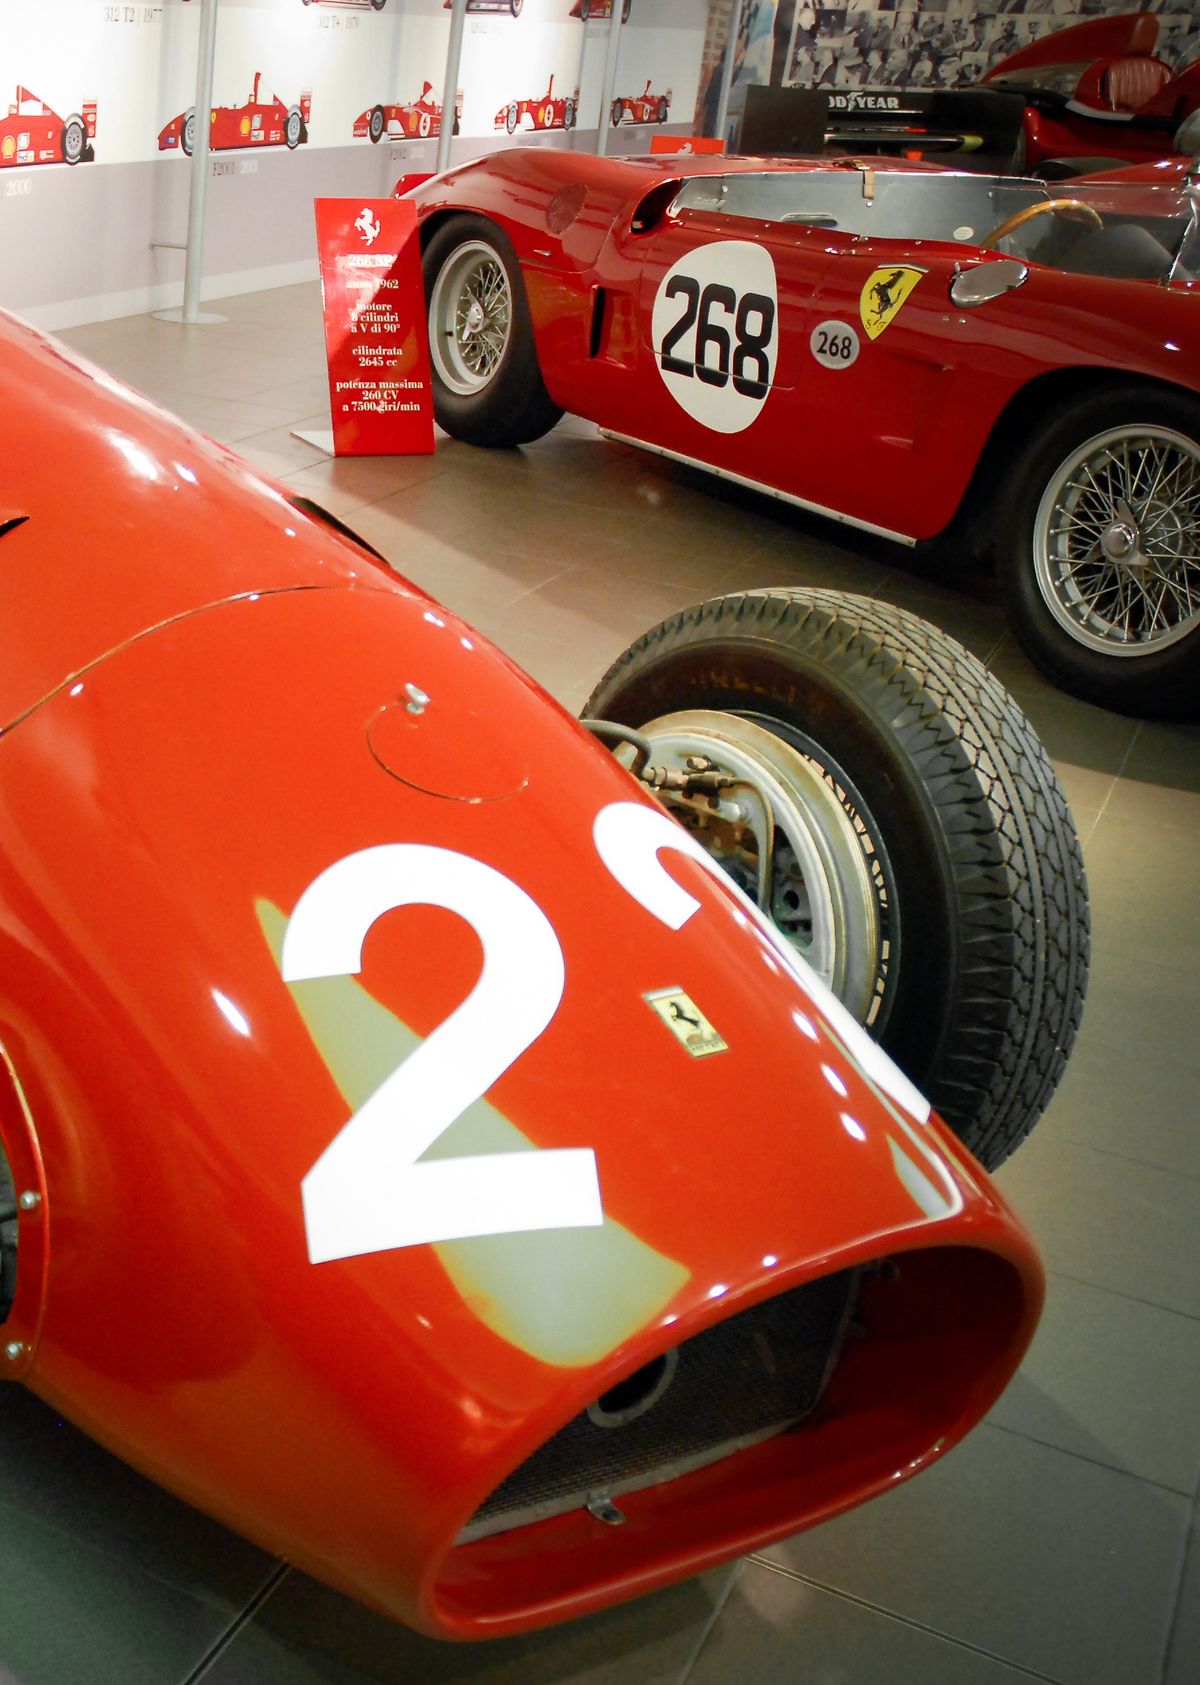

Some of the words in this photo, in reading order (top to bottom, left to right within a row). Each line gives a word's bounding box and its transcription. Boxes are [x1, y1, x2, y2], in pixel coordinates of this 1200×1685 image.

[104, 7, 120, 22] 312
[123, 7, 135, 22] T2
[6, 179, 32, 197] 2000
[375, 279, 399, 289] 1962
[356, 302, 393, 311] motore
[360, 312, 399, 322] cilindri
[360, 323, 369, 333] V
[371, 323, 381, 333] di
[661, 274, 775, 400] 268
[352, 345, 403, 356] cilindrata
[816, 331, 853, 360] 268
[358, 356, 384, 366] 2645
[336, 380, 377, 392] potenza
[379, 379, 424, 388] massima
[362, 390, 381, 400] 260
[383, 390, 399, 400] CV
[351, 401, 376, 411] 7500
[377, 401, 420, 414] giri/min
[281, 843, 604, 1264] 2
